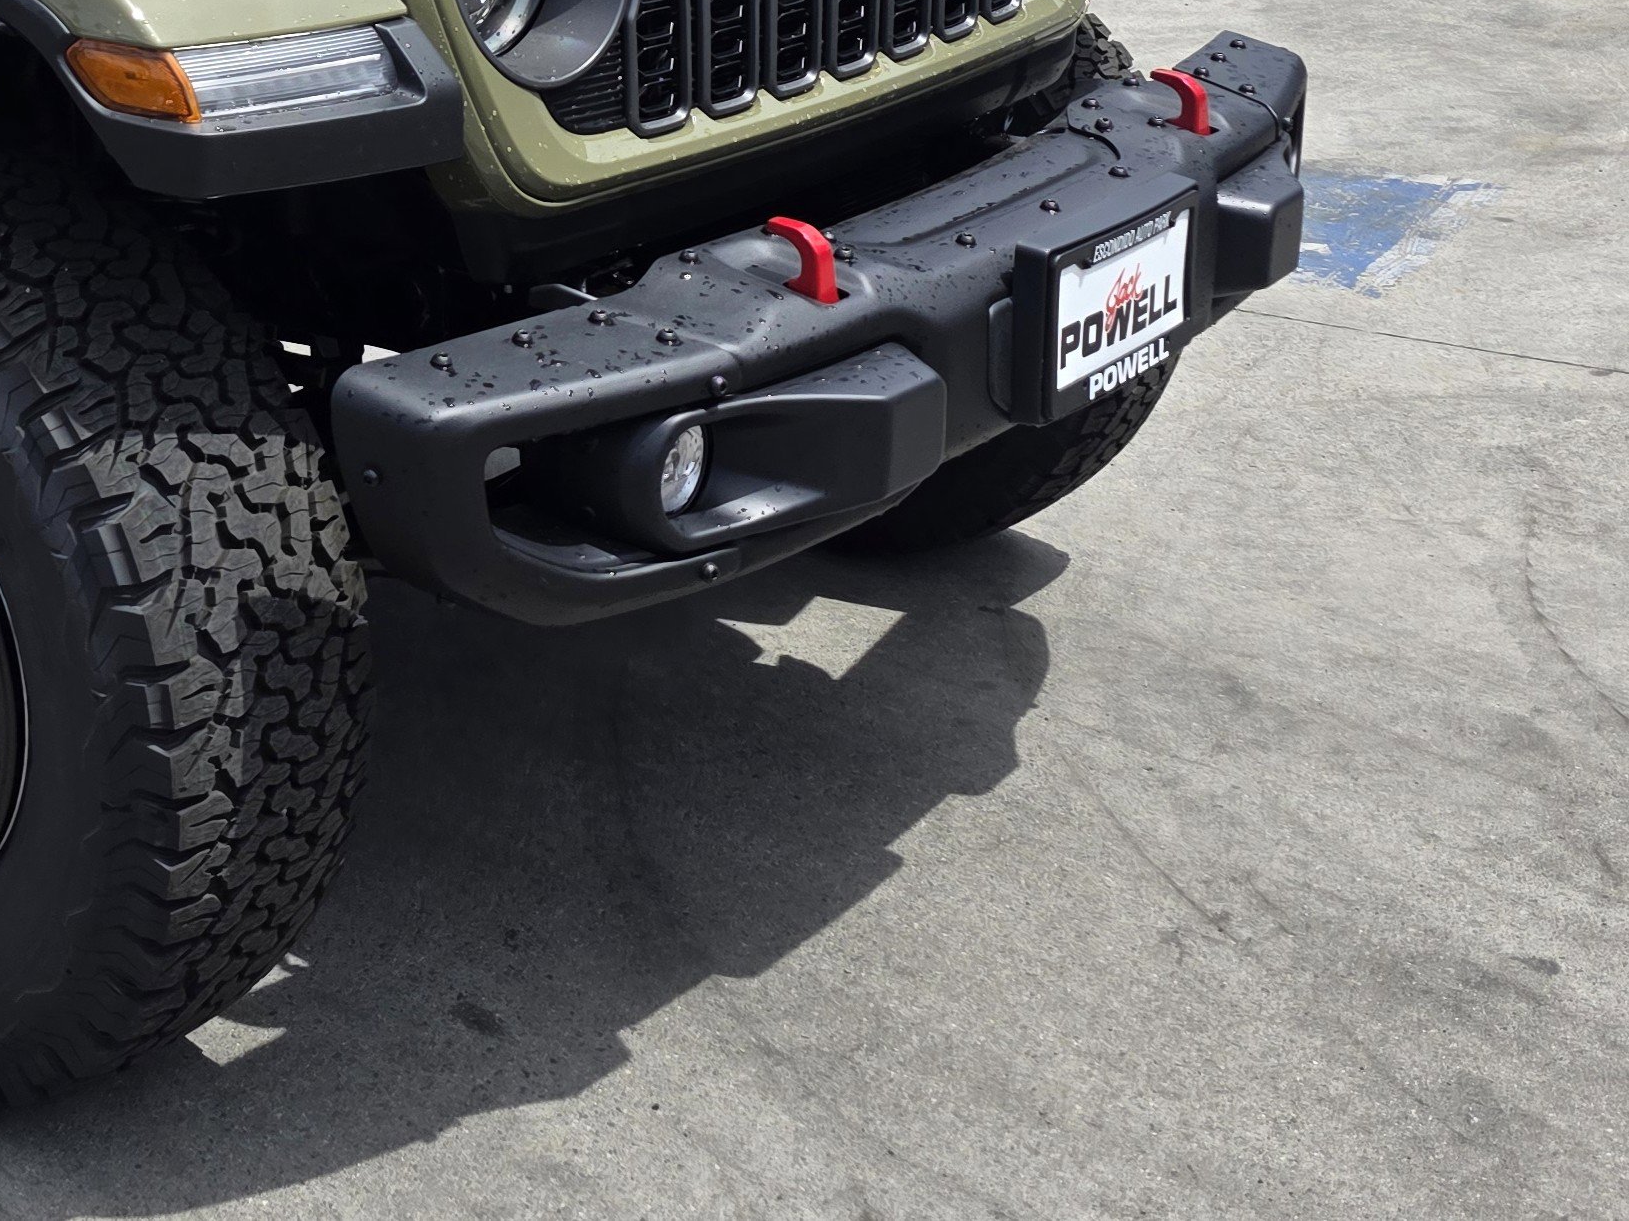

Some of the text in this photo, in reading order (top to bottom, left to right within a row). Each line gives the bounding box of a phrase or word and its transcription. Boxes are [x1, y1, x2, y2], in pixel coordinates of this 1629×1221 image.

[1093, 229, 1136, 263] ESCONDIDO
[1059, 274, 1178, 370] POWELL
[1088, 337, 1170, 401] POWELL
